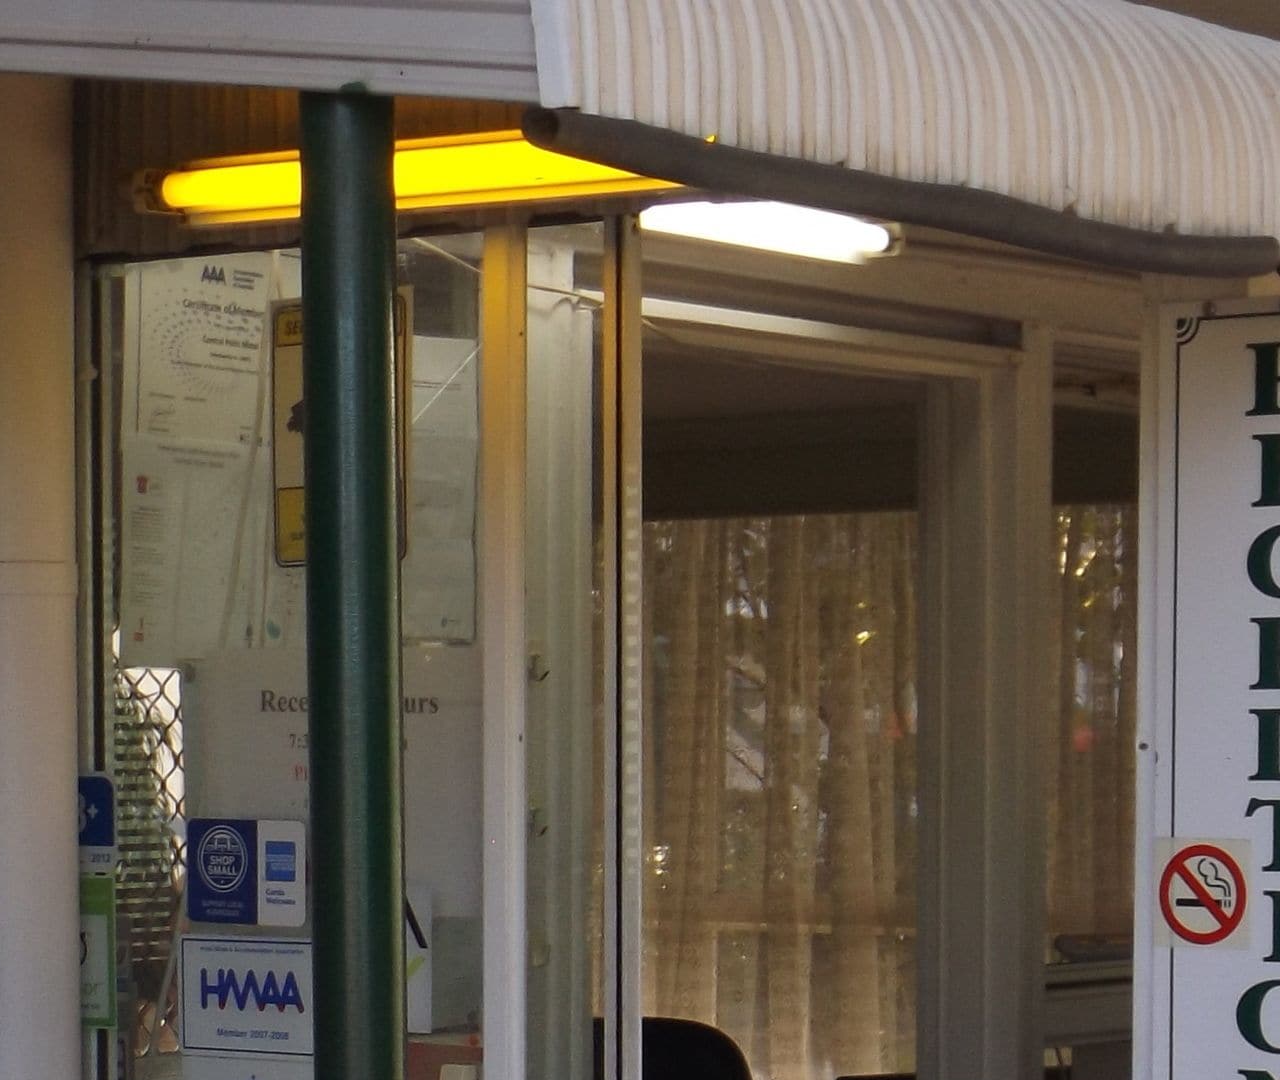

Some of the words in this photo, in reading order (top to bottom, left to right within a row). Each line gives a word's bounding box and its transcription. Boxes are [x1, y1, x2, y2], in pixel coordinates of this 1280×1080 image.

[201, 264, 227, 286] AAA
[404, 696, 439, 714] urs
[209, 855, 235, 865] SHOP
[207, 864, 238, 876] SMALL
[200, 967, 305, 1014] HMAA
[216, 1027, 247, 1038] Member
